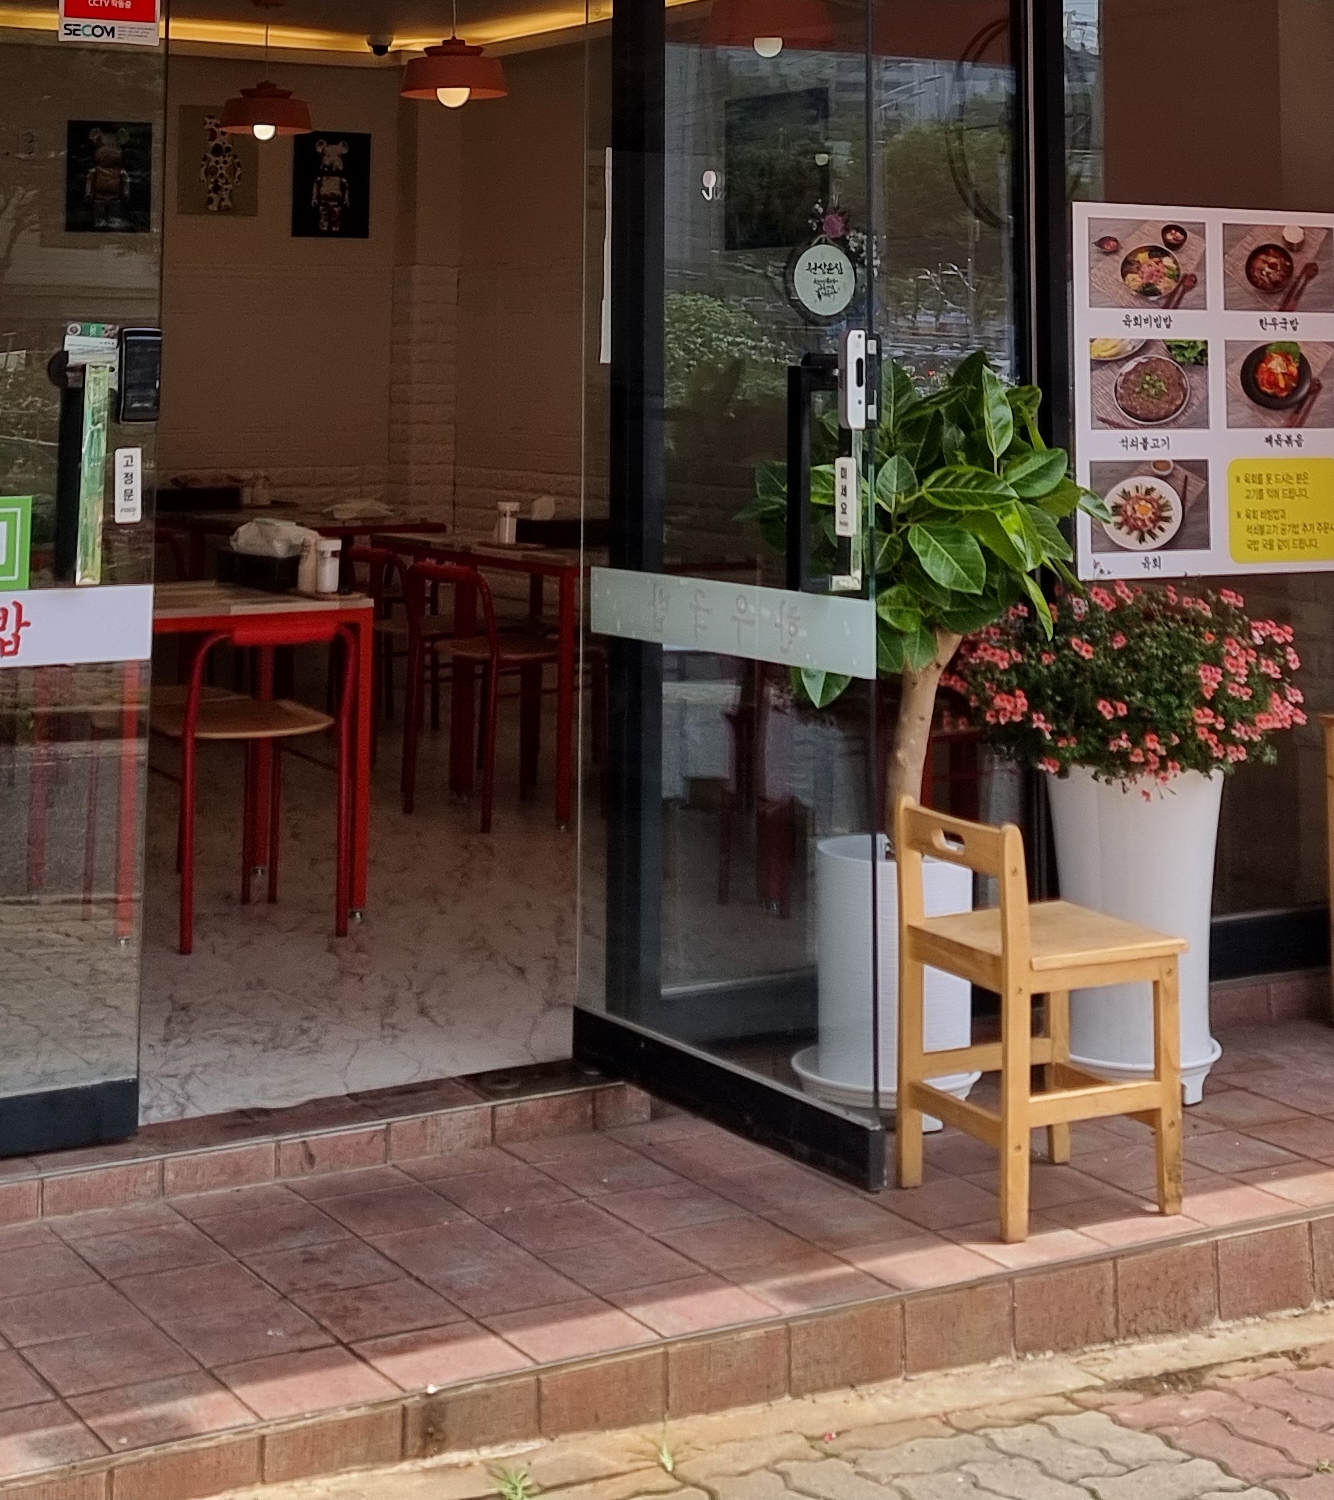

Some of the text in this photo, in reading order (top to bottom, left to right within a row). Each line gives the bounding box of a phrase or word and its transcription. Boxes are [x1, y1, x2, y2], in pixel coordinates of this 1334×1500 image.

[63, 23, 116, 38] SECOM
[1122, 314, 1173, 329] 육회비빔밥
[123, 455, 134, 502] 고정문
[1141, 556, 1161, 571] 육회
